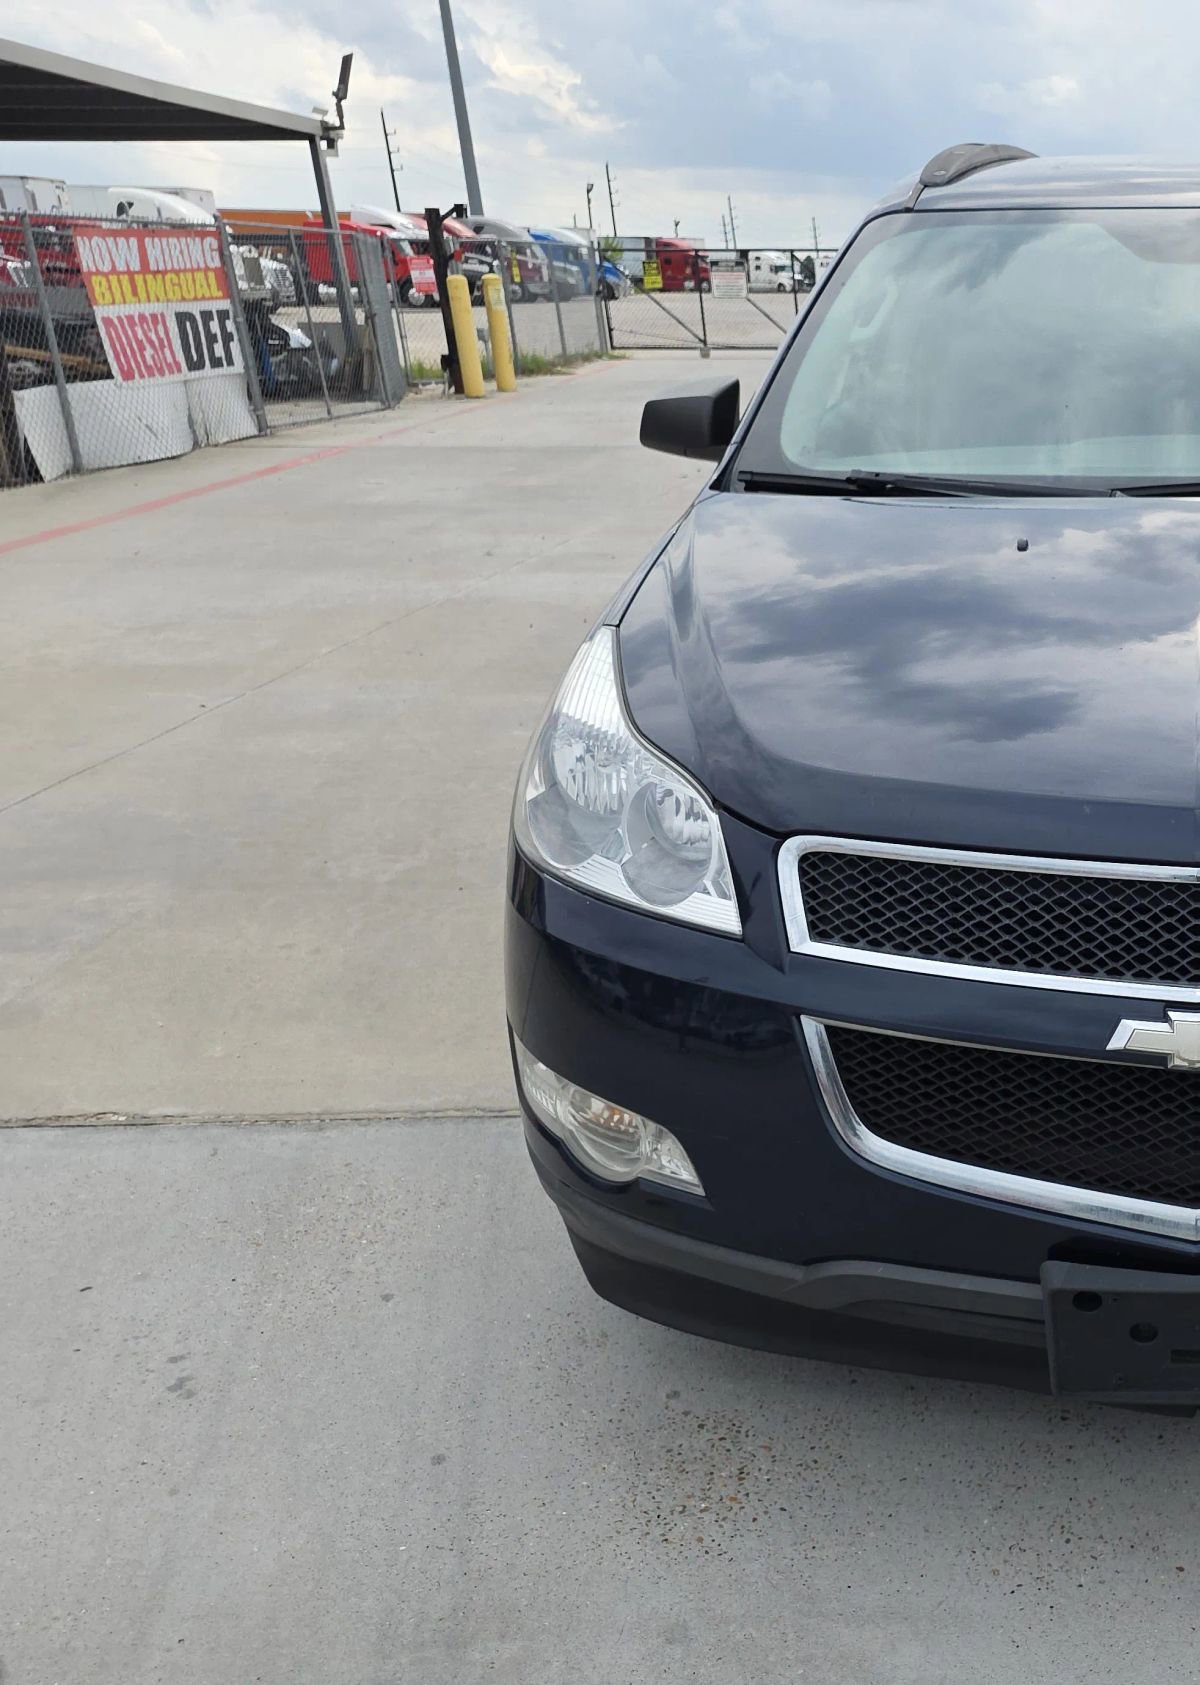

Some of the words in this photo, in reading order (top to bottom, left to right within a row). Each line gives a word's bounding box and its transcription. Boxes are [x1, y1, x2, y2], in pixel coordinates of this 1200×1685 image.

[76, 235, 142, 273] NOW
[144, 235, 222, 271] HIRING
[91, 272, 224, 306] BILINGUAL
[101, 312, 182, 382] DIESEL
[175, 309, 235, 372] DEF
